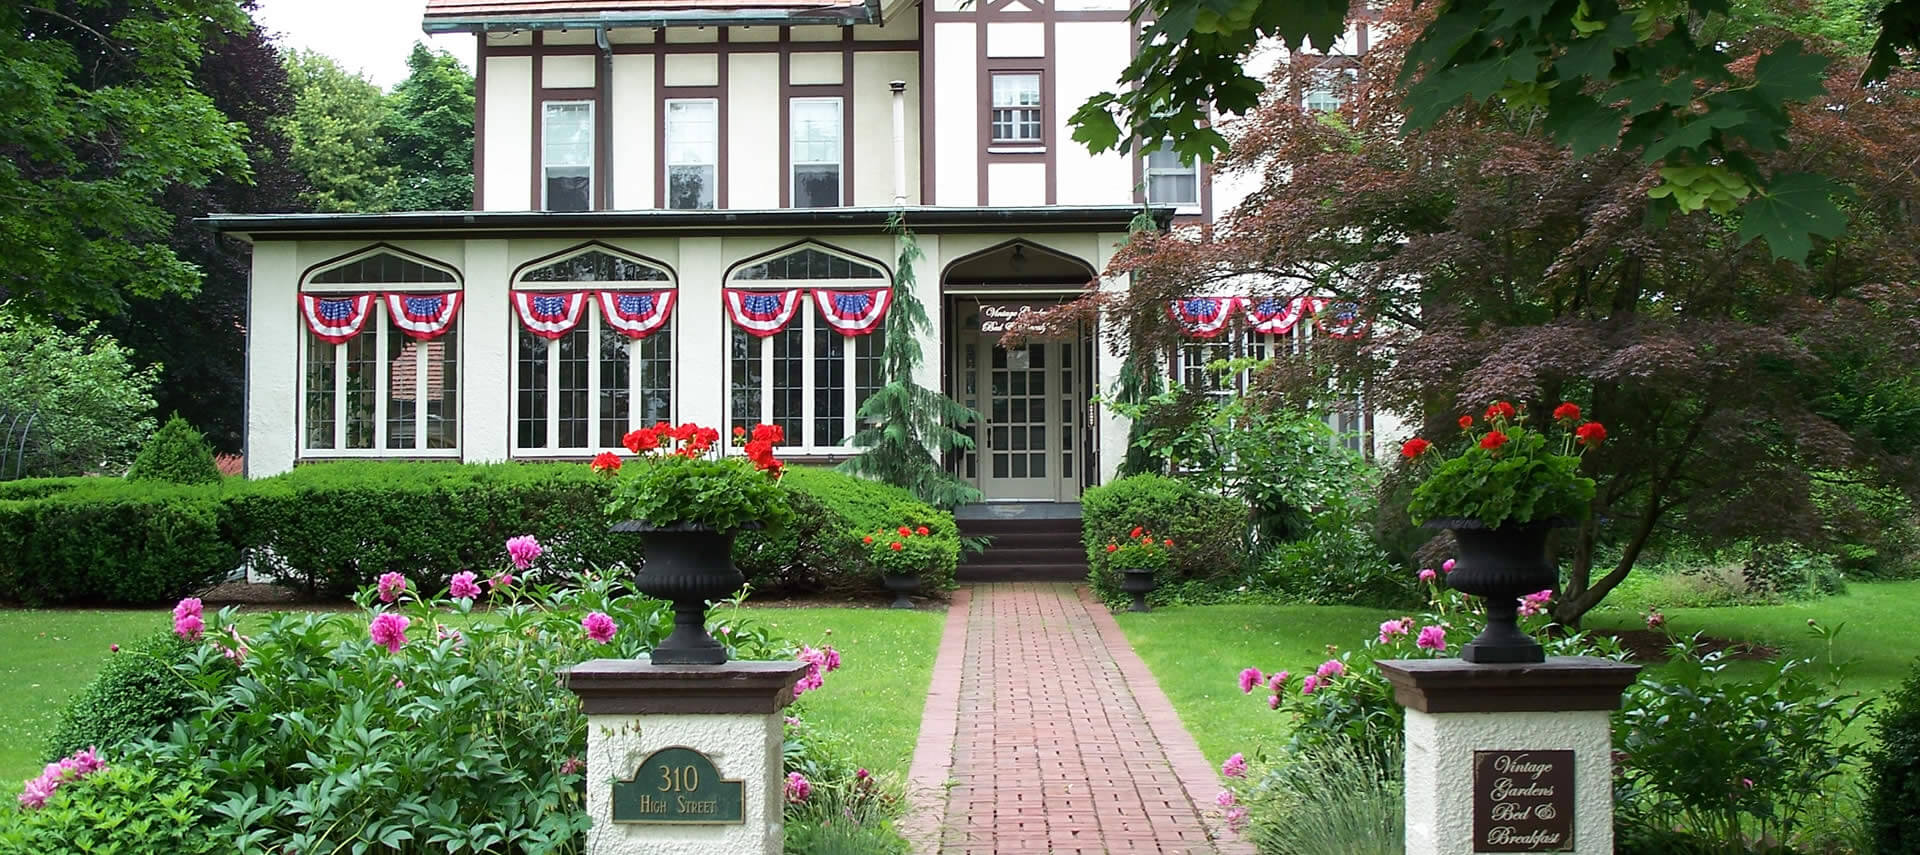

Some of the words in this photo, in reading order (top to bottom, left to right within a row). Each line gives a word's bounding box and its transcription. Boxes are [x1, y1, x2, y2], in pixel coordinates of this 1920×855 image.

[985, 306, 1018, 320] Vintage
[981, 321, 1004, 331] Bed
[658, 765, 698, 792] 310
[1494, 753, 1553, 780] Vintage
[1490, 777, 1554, 802] Gardens
[1491, 802, 1532, 821] Bed
[1534, 802, 1556, 820] &
[1487, 826, 1560, 850] Breakfast
